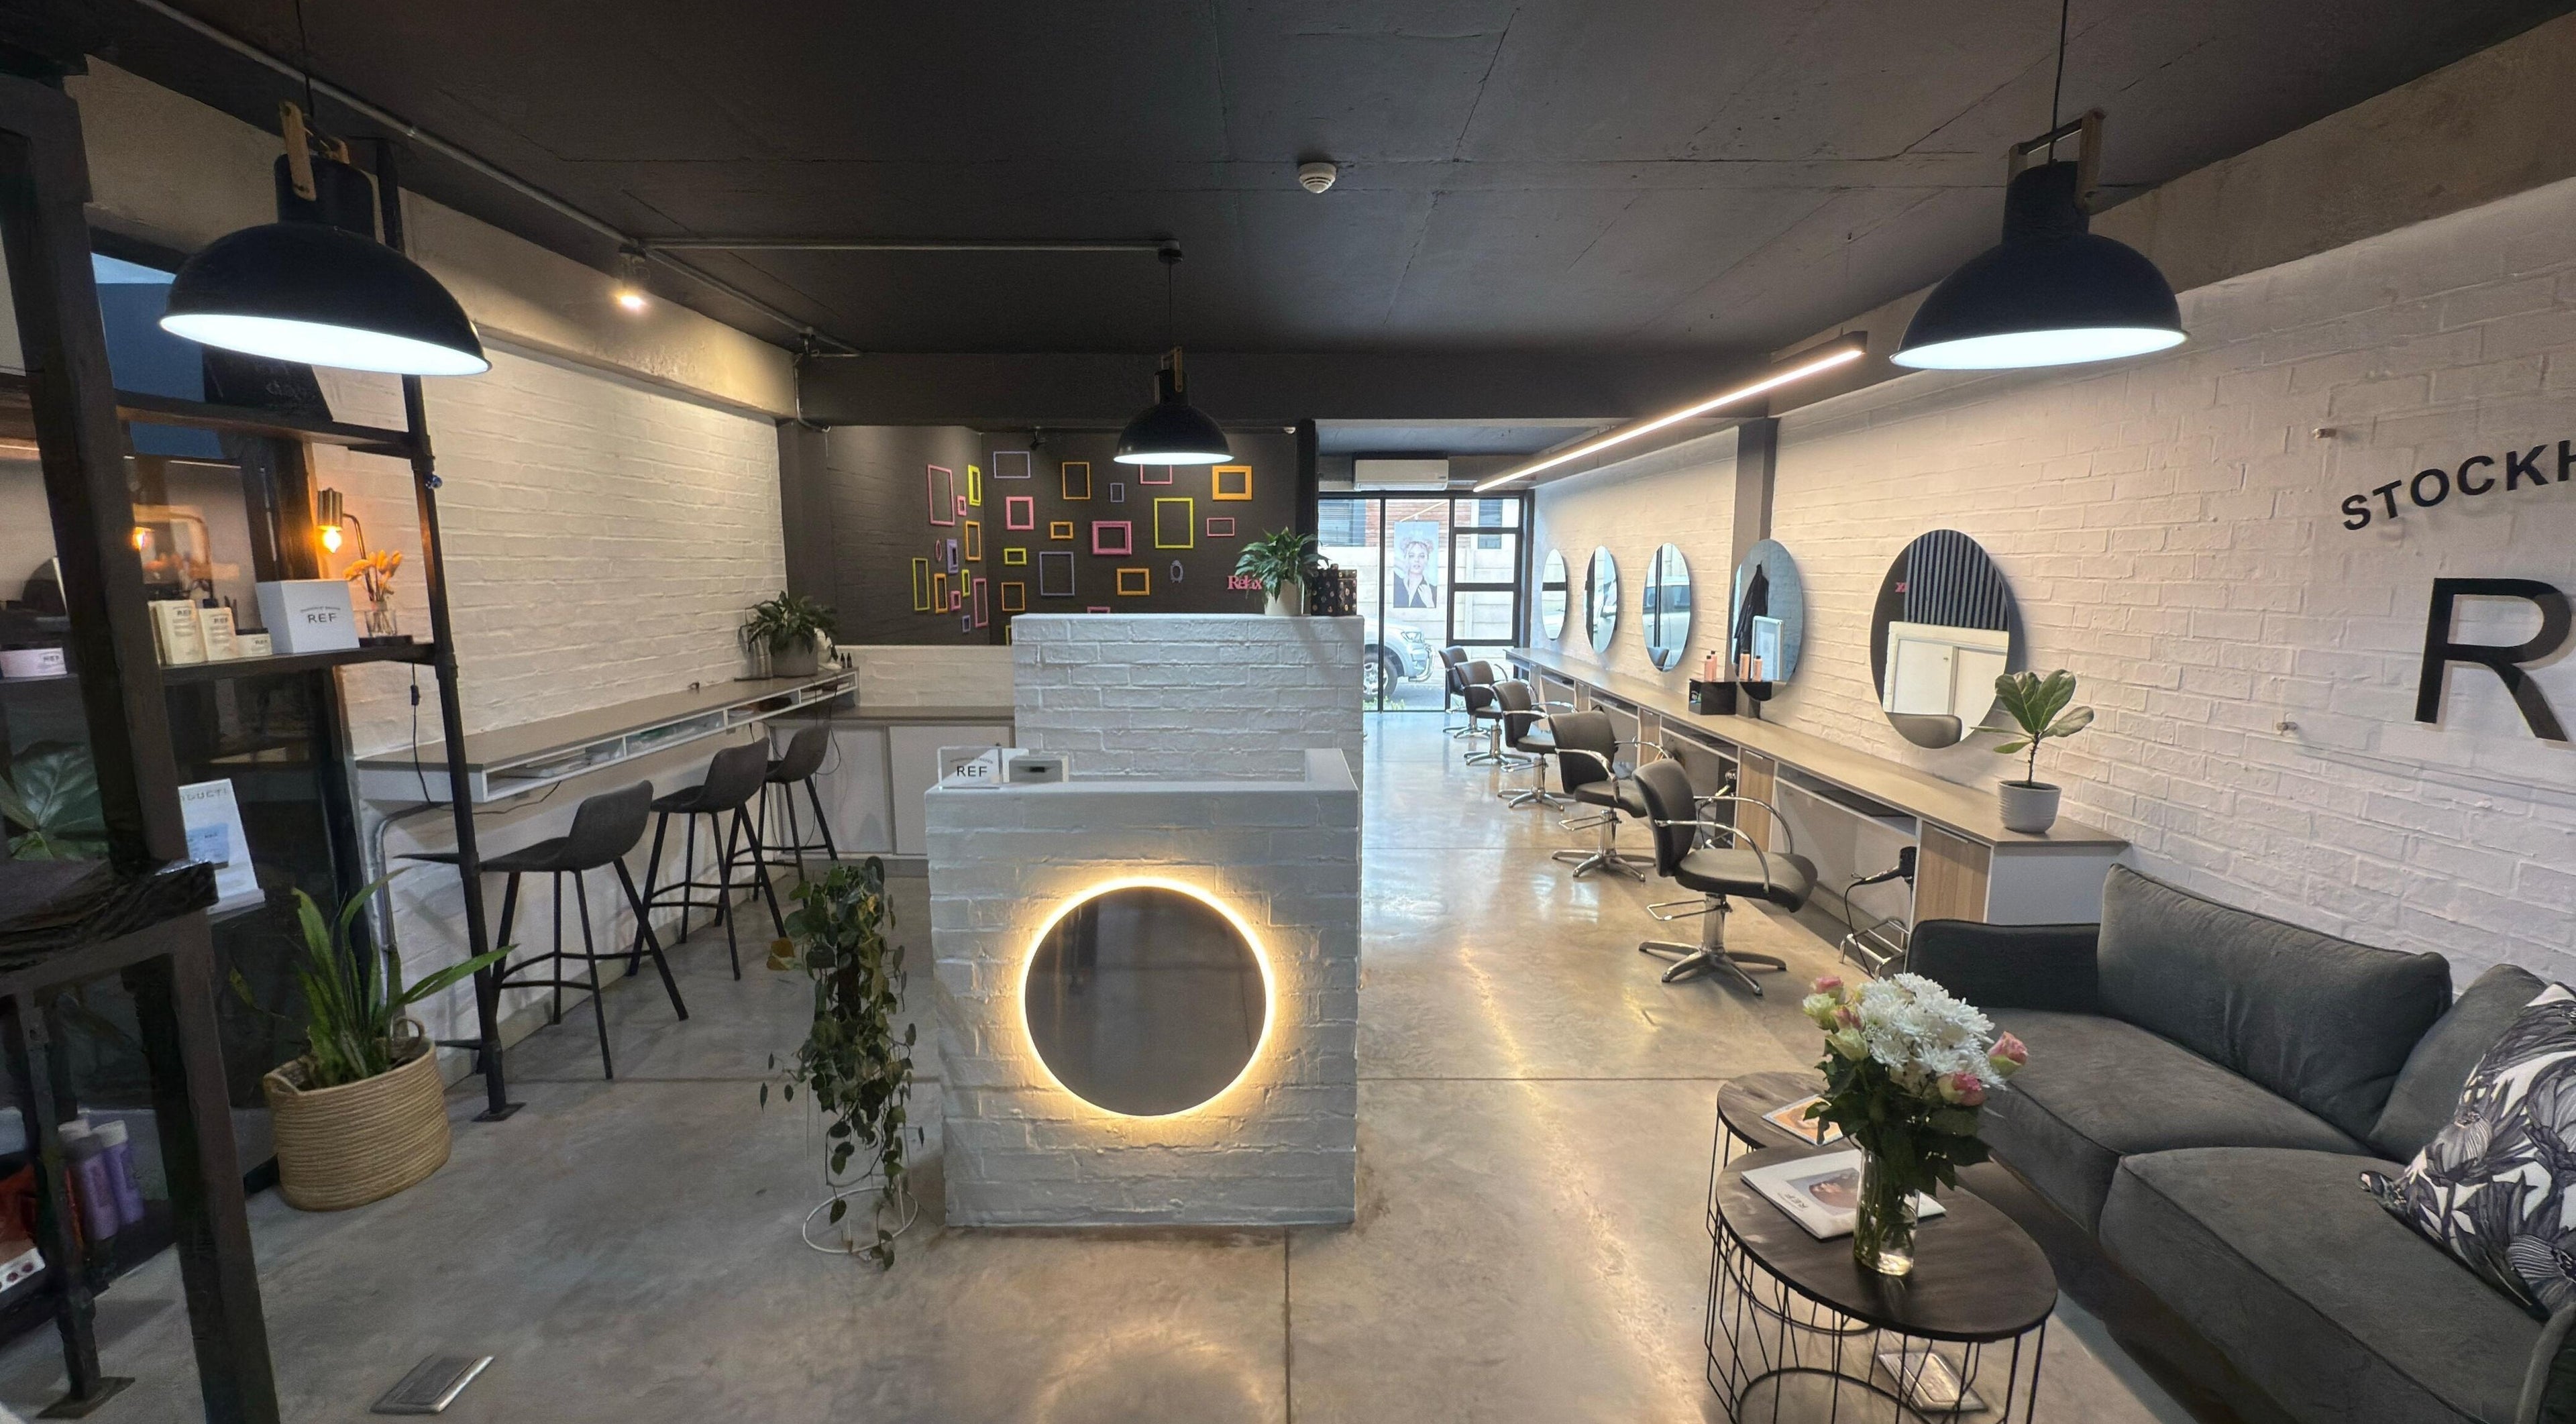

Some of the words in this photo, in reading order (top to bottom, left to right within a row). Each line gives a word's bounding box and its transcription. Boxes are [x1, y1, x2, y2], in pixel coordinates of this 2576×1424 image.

[307, 612, 337, 624] REF
[2415, 578, 2572, 742] R
[957, 766, 987, 777] REF
